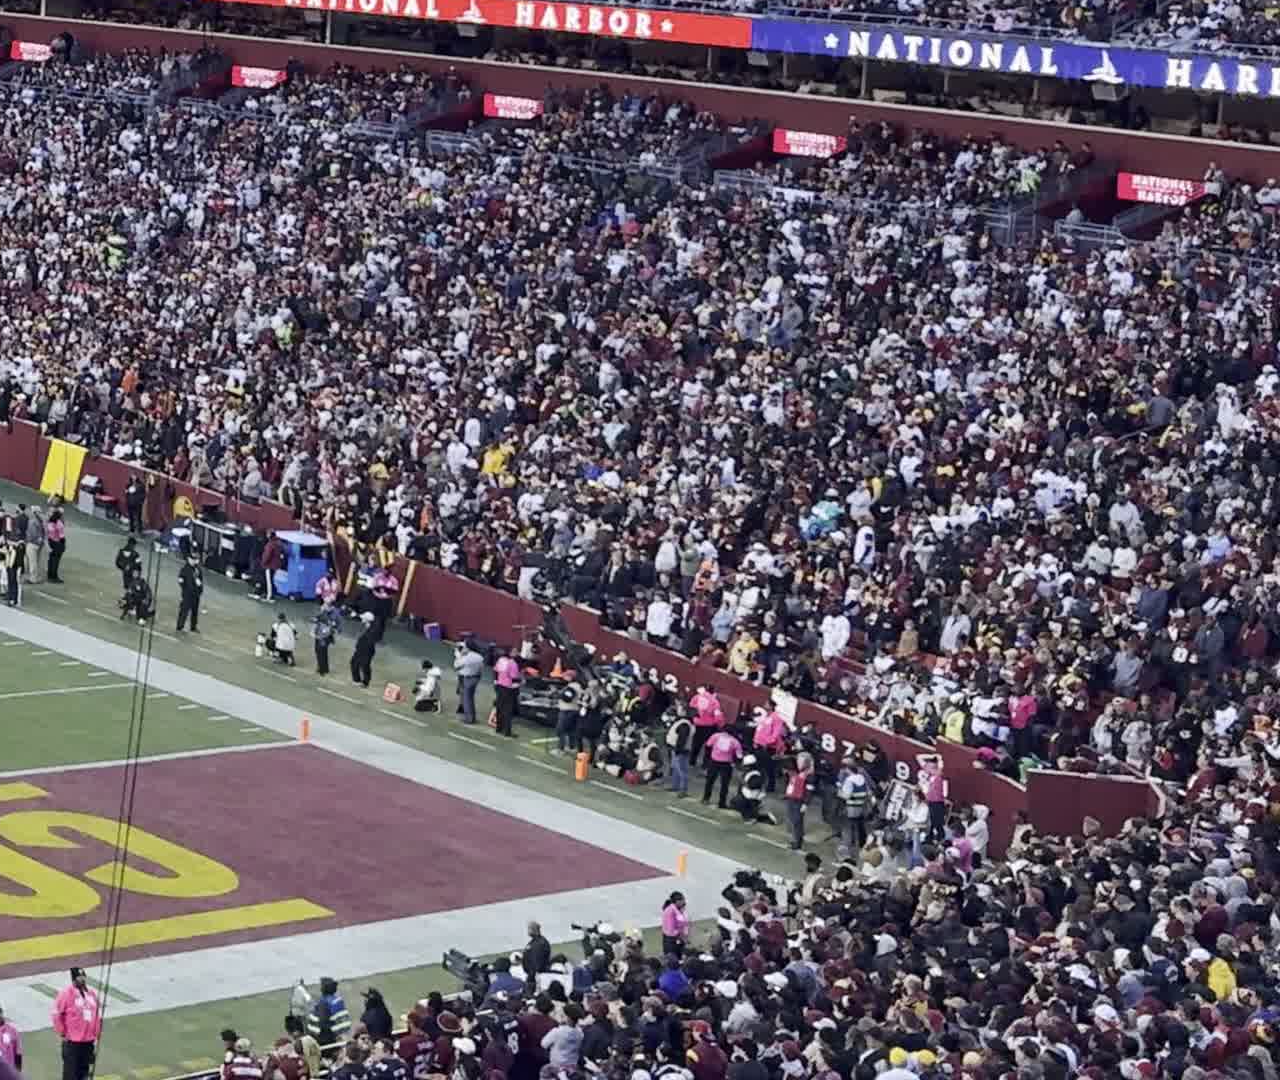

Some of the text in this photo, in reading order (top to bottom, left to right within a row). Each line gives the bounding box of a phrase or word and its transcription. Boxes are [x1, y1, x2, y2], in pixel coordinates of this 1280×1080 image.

[516, 3, 652, 37] HARBOR
[848, 30, 1058, 76] NATIONAL
[1132, 174, 1193, 195] NATIONAL
[1137, 190, 1187, 206] HARBOR
